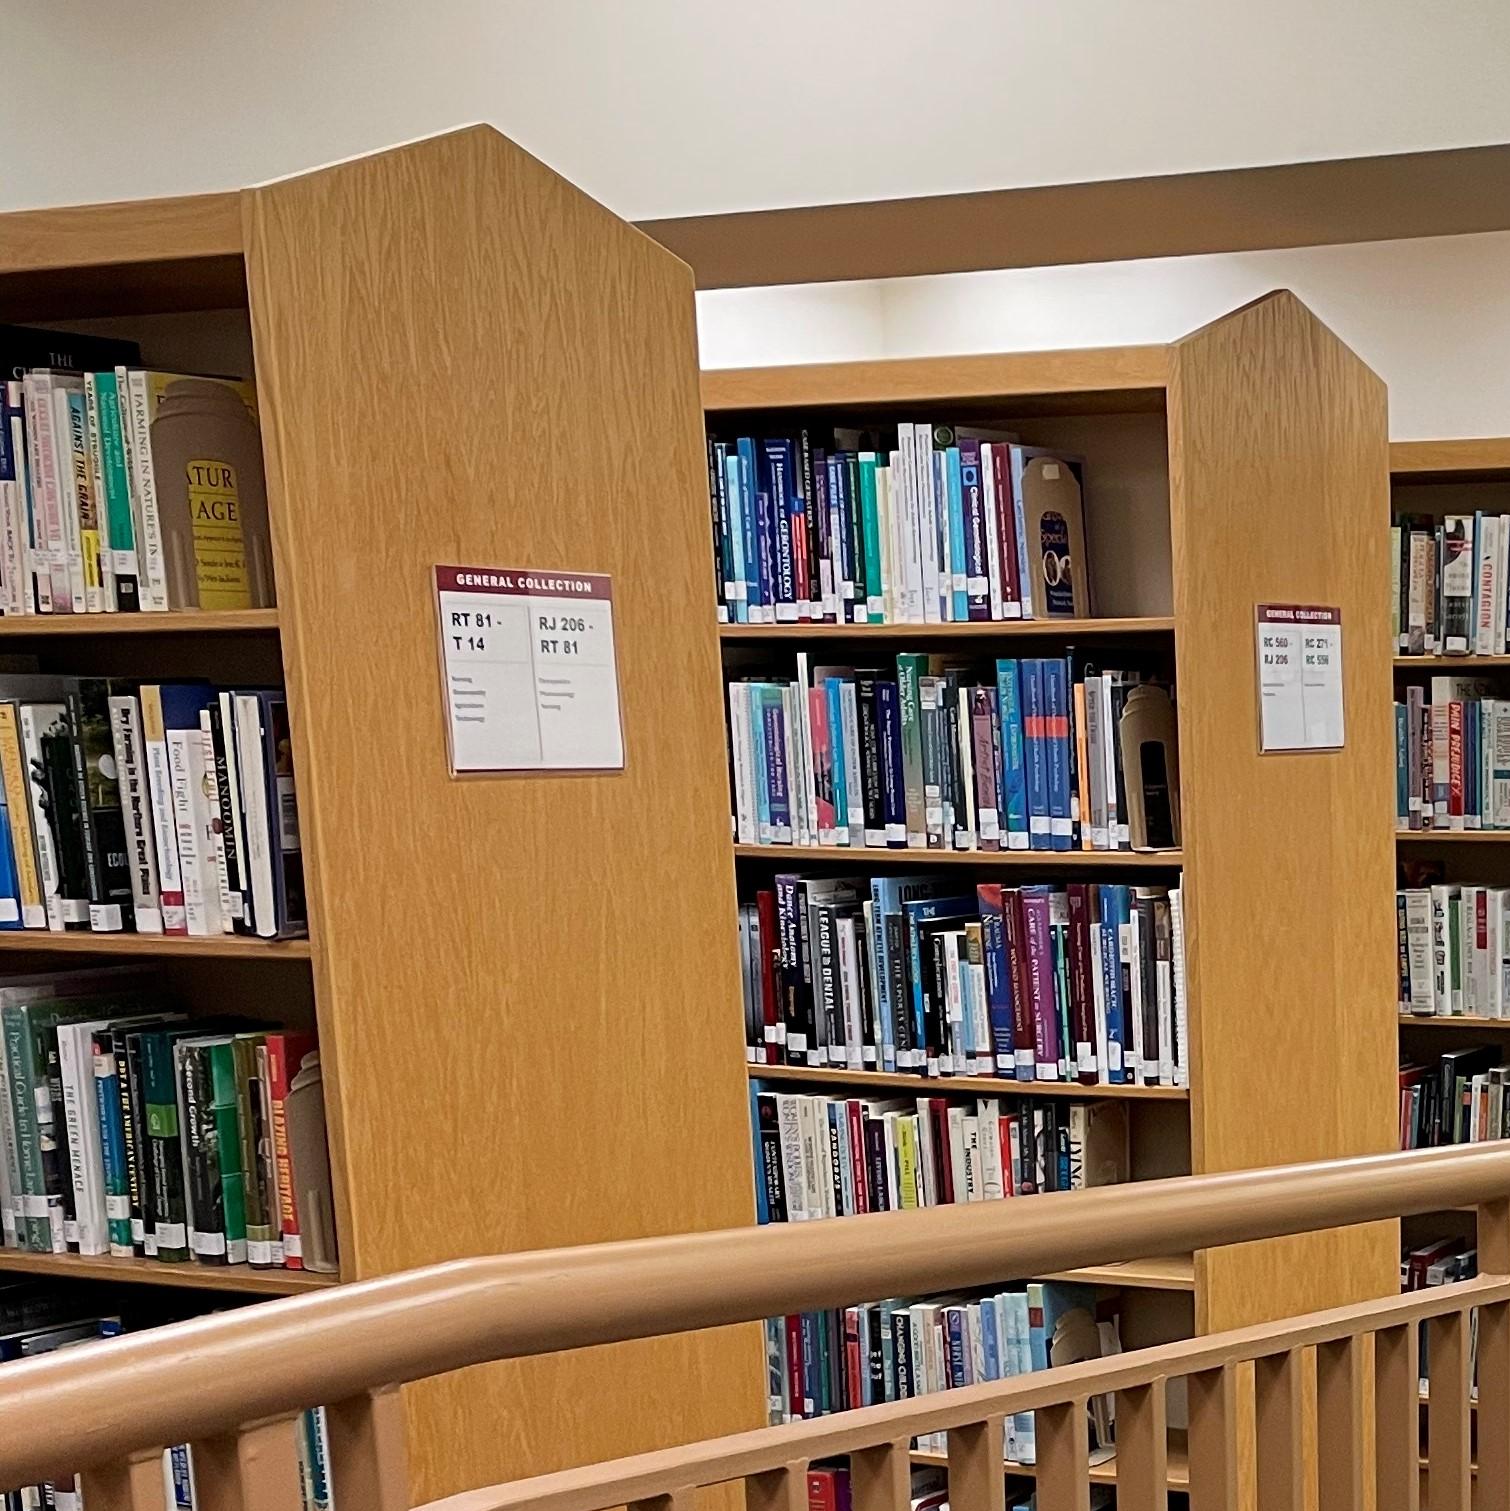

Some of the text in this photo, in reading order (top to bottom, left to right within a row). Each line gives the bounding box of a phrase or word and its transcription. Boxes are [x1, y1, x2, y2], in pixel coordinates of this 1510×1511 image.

[87, 380, 95, 412] YEARS
[134, 393, 148, 456] FARMING
[141, 459, 151, 474] IN
[71, 406, 90, 521] AGAINST THE GRAIN
[456, 573, 592, 593] GENERAL COLLECTION
[780, 519, 793, 600] GERONTOLOGY
[1266, 609, 1332, 621] GENERAL COLLECTION
[1480, 563, 1493, 628] CONTAGION
[452, 612, 492, 628] RT 81
[453, 636, 485, 651] T 14
[539, 616, 585, 632] RJ 206
[541, 639, 578, 655] RT 81
[121, 707, 131, 725] Dry
[904, 665, 915, 722] Nursing Care
[1450, 703, 1460, 724] PAIN
[123, 728, 137, 765] Farming
[152, 747, 162, 768] Plant
[129, 778, 139, 793] the
[173, 740, 188, 812] Food Fight
[216, 756, 236, 861] MANOOMIN
[137, 839, 149, 866] Great
[777, 884, 790, 969] and Kinesiology
[785, 885, 798, 968] Dance Anatomy
[1028, 908, 1036, 933] CARE
[818, 910, 835, 1012] LEAGUE DENIAL
[878, 955, 888, 1004] DEVELOPMENT
[933, 937, 943, 998] Complications
[1032, 958, 1040, 1000] PATIENT
[893, 959, 905, 1022] THE SPORTS
[1013, 982, 1023, 1032] MANAGEMENT
[9, 1031, 26, 1080] Practical
[1035, 1011, 1044, 1057] SURGERY
[15, 1081, 29, 1116] Guide
[185, 1059, 200, 1148] Second Growth
[64, 1084, 84, 1193] THE GREEN MENACE
[831, 1128, 841, 1190] PANDORA'S
[276, 1157, 293, 1222] HERITAGE
[964, 1148, 974, 1194] INDUSTRY
[896, 1316, 906, 1364] CHANGING
